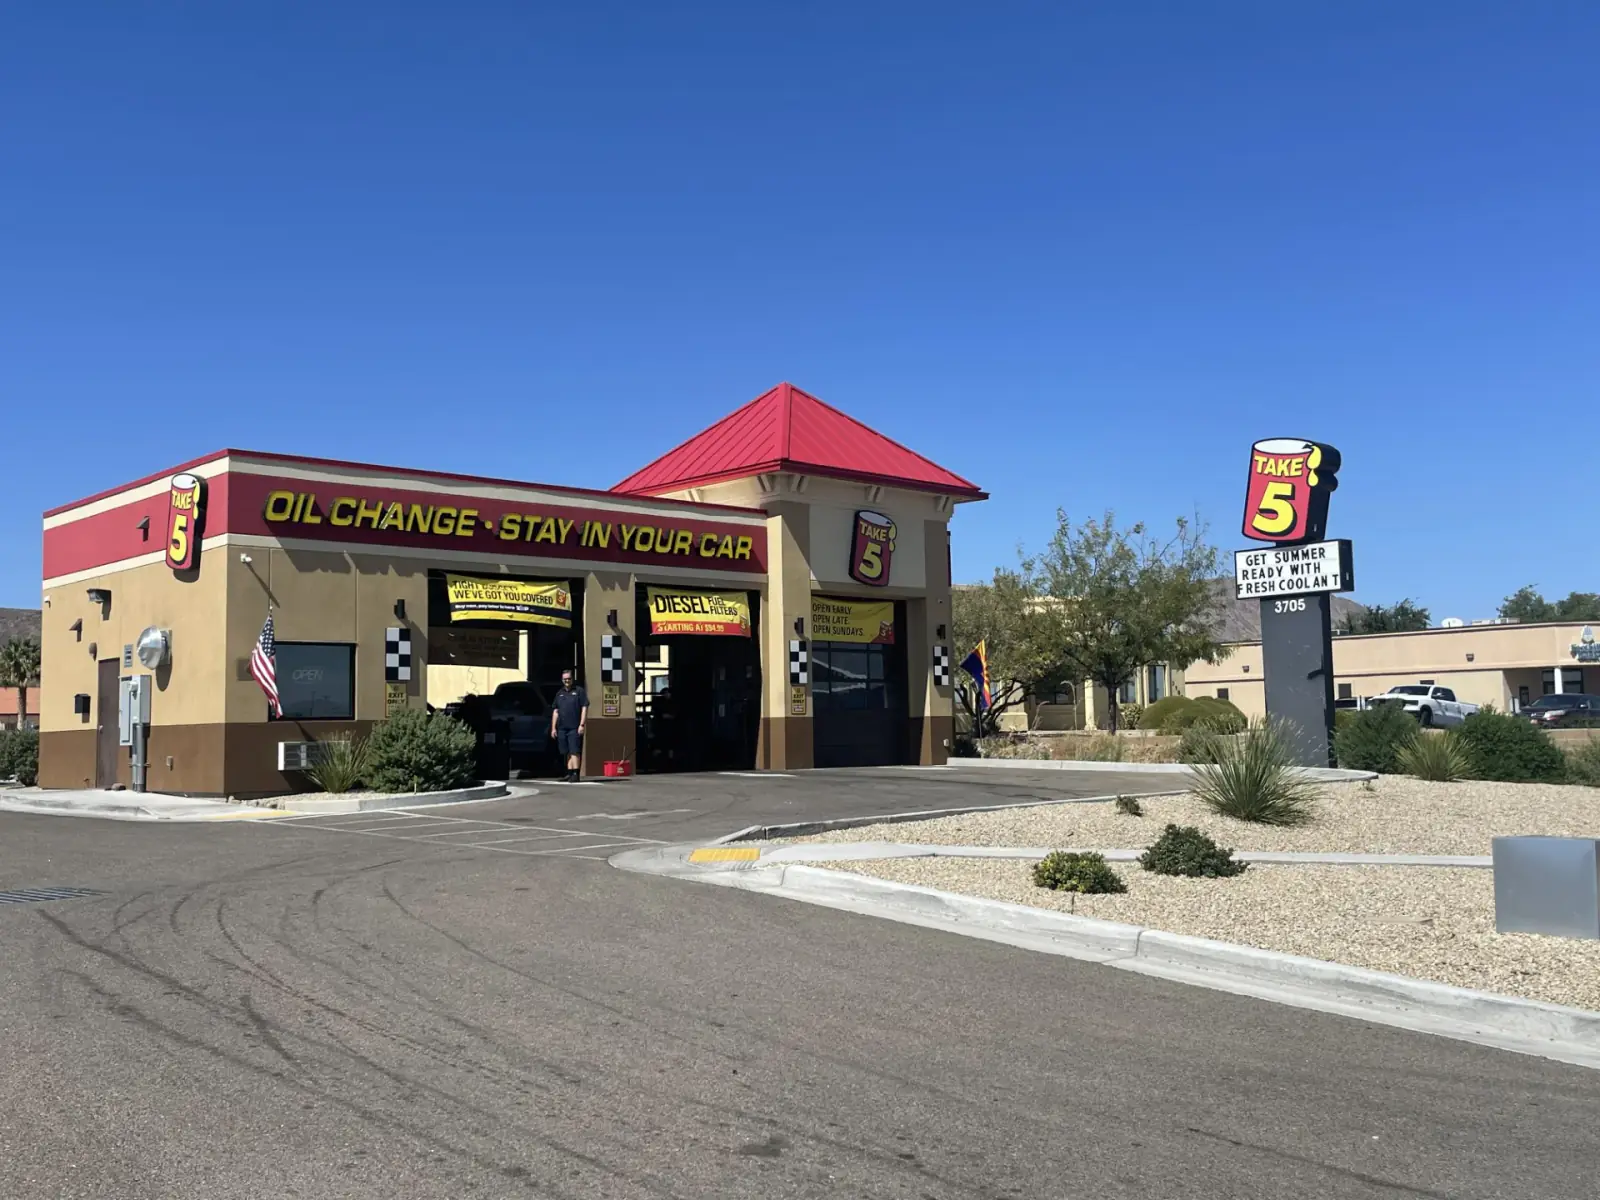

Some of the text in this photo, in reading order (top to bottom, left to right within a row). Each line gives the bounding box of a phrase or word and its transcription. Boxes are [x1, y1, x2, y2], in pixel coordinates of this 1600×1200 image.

[1254, 455, 1304, 477] TAKE
[172, 489, 192, 510] TAKE
[1252, 481, 1297, 537] 5
[264, 490, 753, 560] OIL CHANGE STAY IN YOUR CAR
[860, 521, 887, 541] TAKE
[169, 513, 188, 565] 5
[859, 541, 883, 579] 5
[1246, 547, 1326, 567] GET SUMMER
[1242, 562, 1321, 580] READY WITH
[1238, 579, 1275, 595] FRESH
[454, 590, 553, 605] WE'VE GOT YOU COVERED
[653, 595, 725, 614] DIESEL FUEL
[1274, 600, 1306, 613] 3705
[709, 606, 738, 616] FILTERS
[812, 603, 831, 613] OPEN
[658, 622, 694, 632] STARTING
[812, 614, 831, 623] OPEN
[813, 624, 831, 634] OPEN
[292, 669, 324, 681] OPEN
